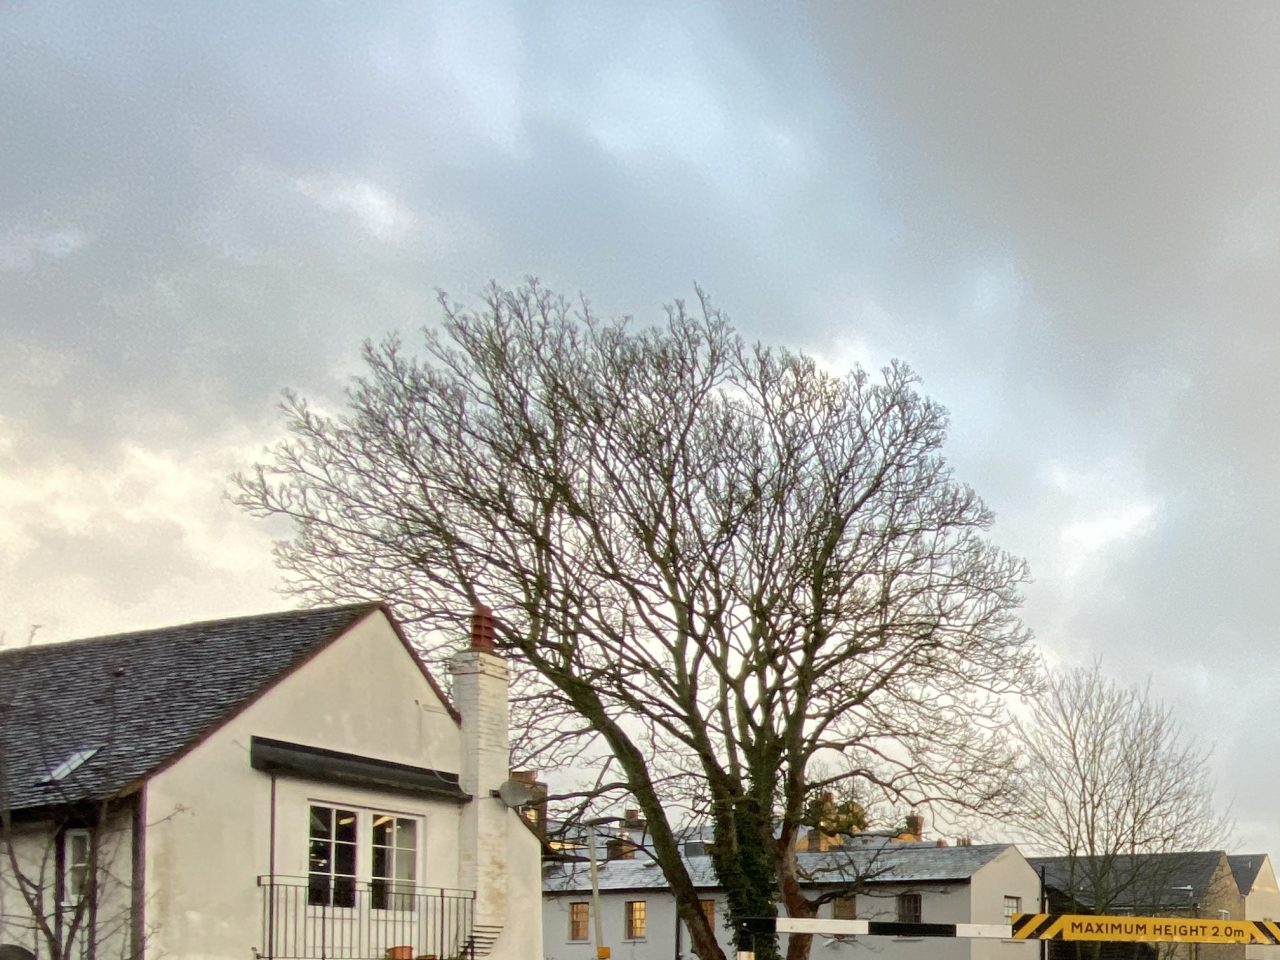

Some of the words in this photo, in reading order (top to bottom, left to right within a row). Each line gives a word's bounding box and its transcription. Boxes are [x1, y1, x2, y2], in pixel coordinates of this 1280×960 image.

[1071, 922, 1147, 935] MAXIMUM
[1153, 924, 1208, 937] HEIGHT
[1212, 926, 1244, 937] 2.0m
